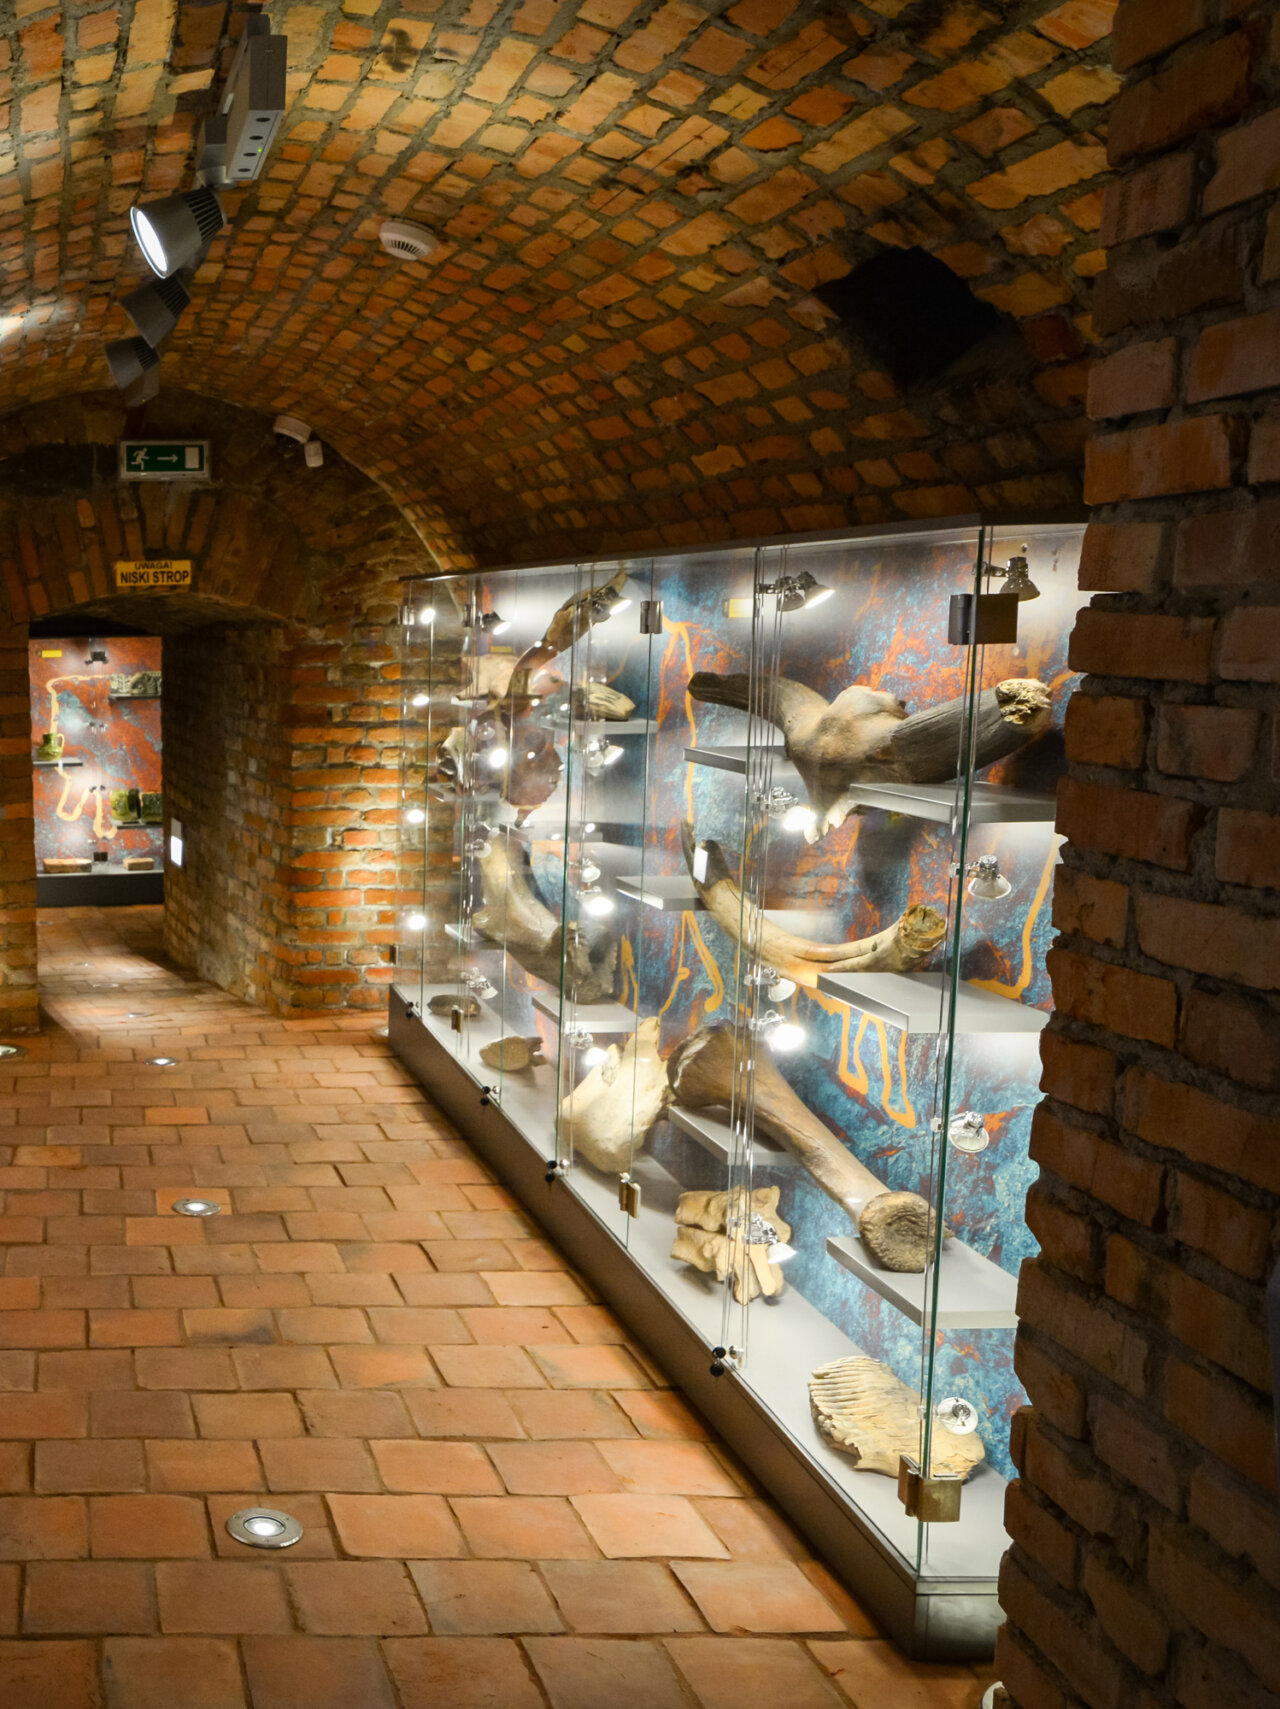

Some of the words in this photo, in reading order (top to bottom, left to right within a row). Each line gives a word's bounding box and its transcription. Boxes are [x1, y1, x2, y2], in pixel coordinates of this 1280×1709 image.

[134, 561, 173, 570] UWAGA!
[120, 571, 150, 584] NISKI
[152, 570, 190, 583] STROP
